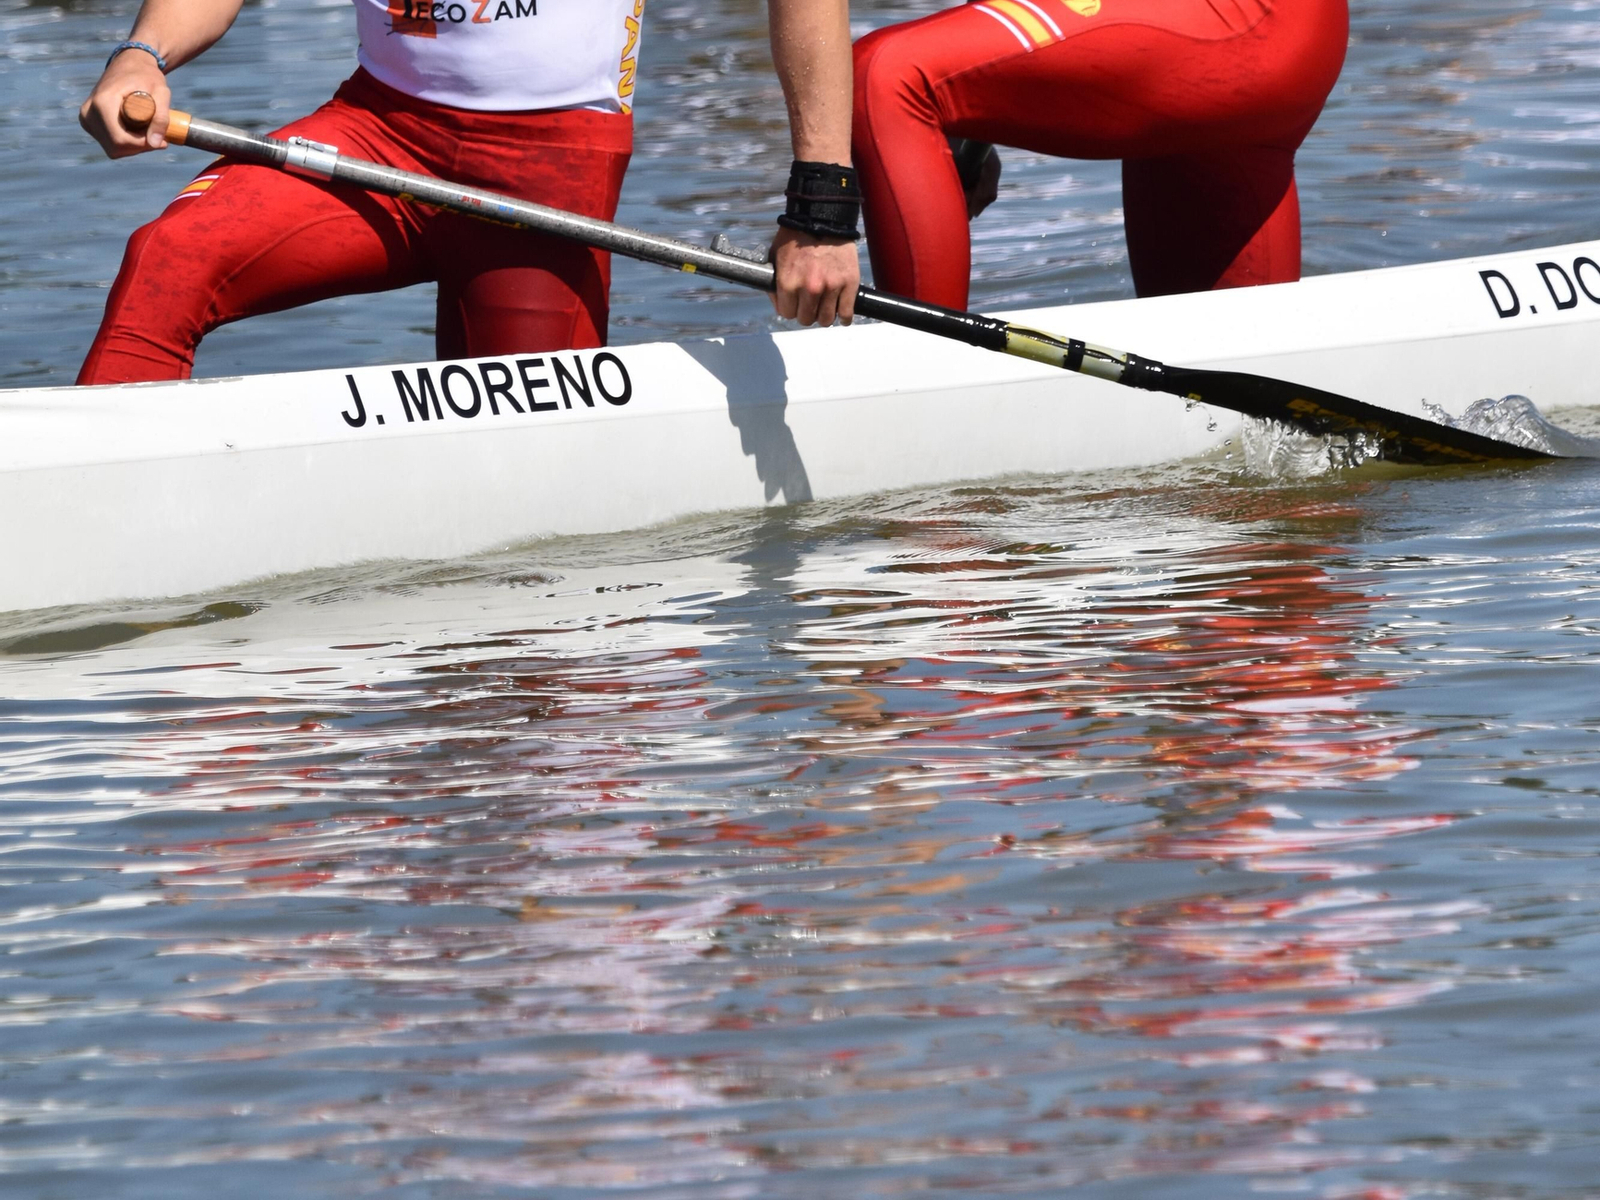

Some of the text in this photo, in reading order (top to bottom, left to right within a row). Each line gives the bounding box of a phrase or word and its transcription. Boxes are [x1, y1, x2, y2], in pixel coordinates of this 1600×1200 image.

[1478, 270, 1538, 319] D.
[341, 351, 633, 428] J. MORENO
